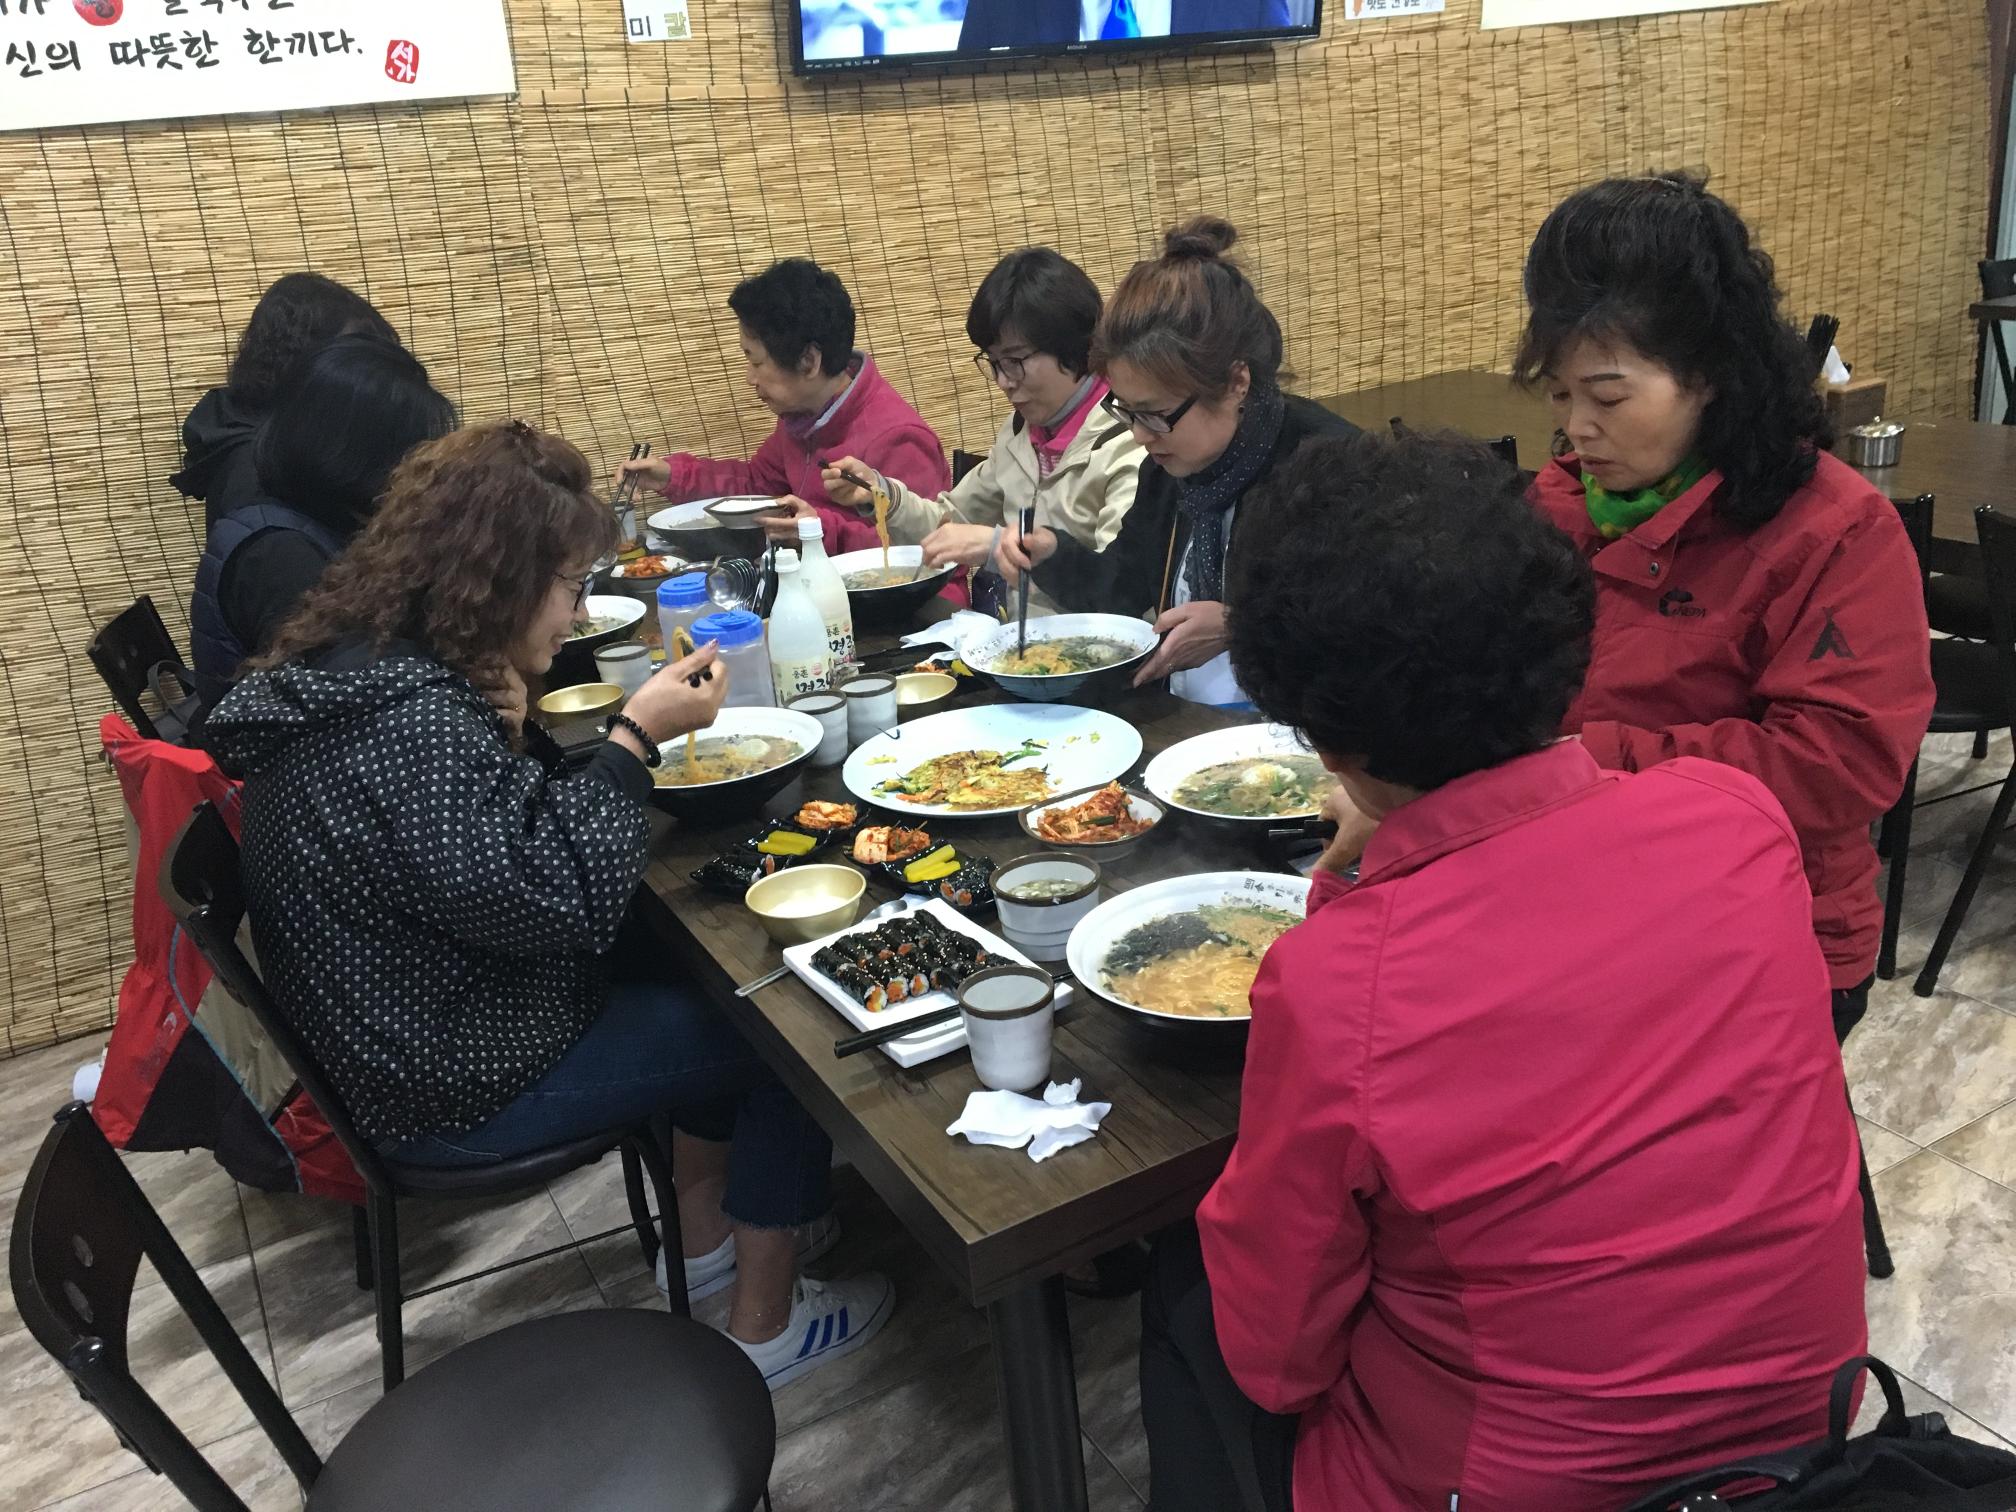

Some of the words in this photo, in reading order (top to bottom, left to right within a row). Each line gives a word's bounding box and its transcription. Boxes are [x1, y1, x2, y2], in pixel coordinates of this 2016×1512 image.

[629, 15, 652, 37] 미
[6, 40, 81, 78] 신의
[109, 29, 220, 70] 따뜻한
[243, 28, 363, 65] 한끼다.
